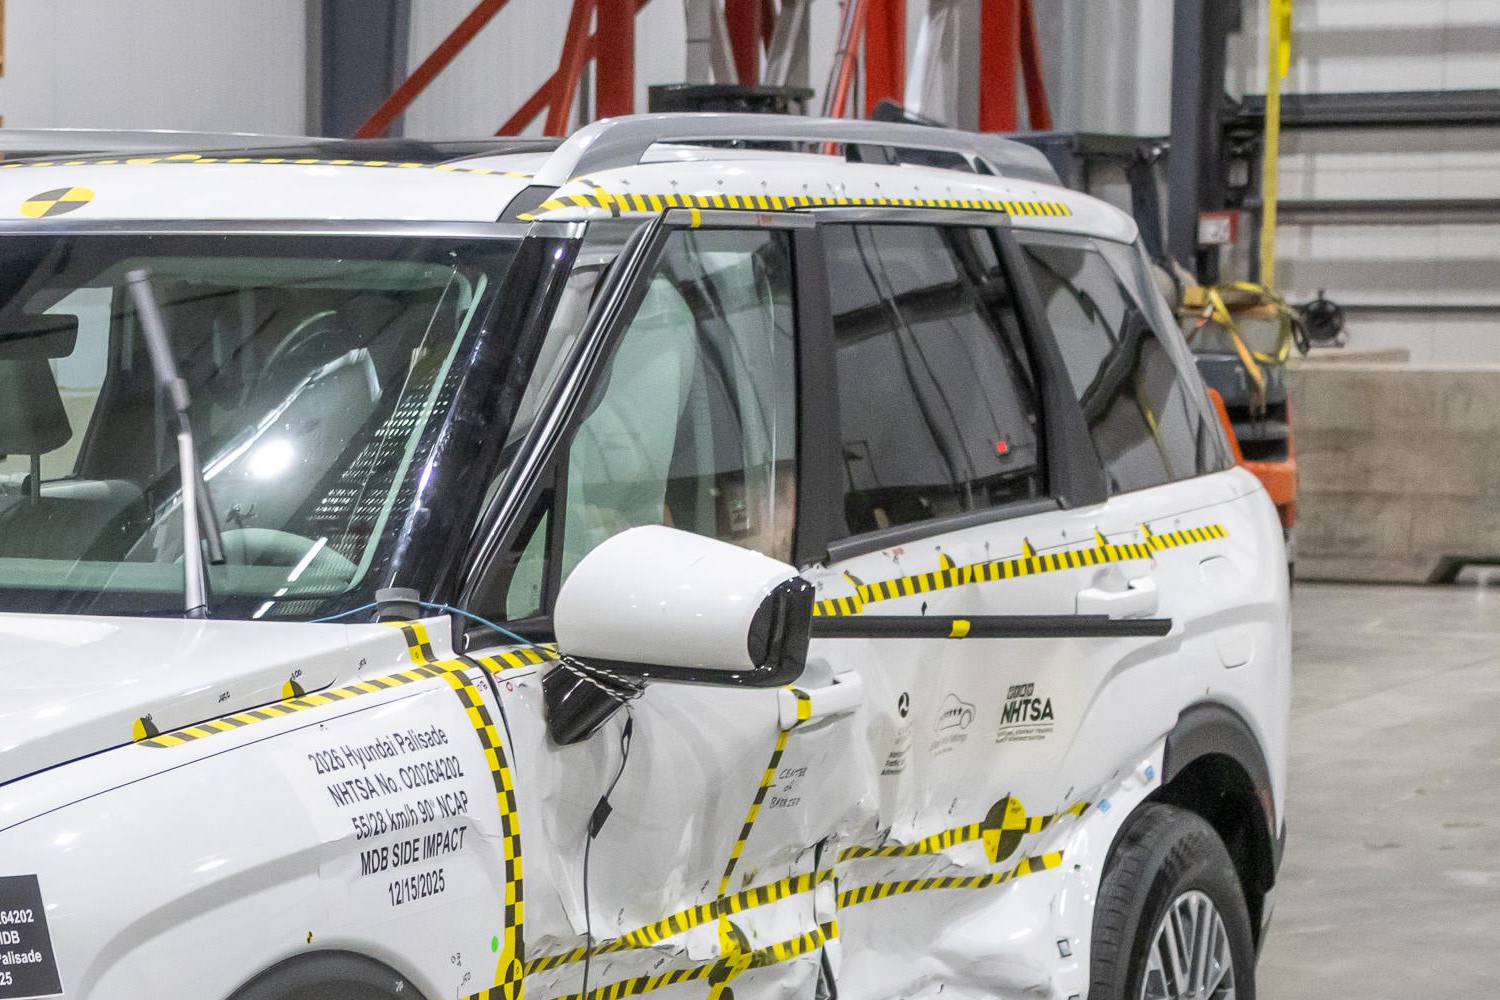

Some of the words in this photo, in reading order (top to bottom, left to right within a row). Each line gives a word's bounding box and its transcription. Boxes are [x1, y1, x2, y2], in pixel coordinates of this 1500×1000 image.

[1001, 698, 1054, 724] NHTSA
[308, 748, 345, 775] 2026
[340, 735, 398, 770] Hyundai
[393, 725, 448, 754] Palisade
[327, 777, 380, 807] NHTSA
[375, 773, 402, 795] No.
[399, 756, 464, 789] O20264202
[352, 811, 387, 840] 55/28
[386, 804, 419, 831] km/h
[438, 790, 468, 819] NCAP
[361, 847, 388, 876] MDB
[392, 838, 419, 868] SIDE
[423, 826, 467, 859] IMPACT
[389, 868, 445, 906] 12/15/2025
